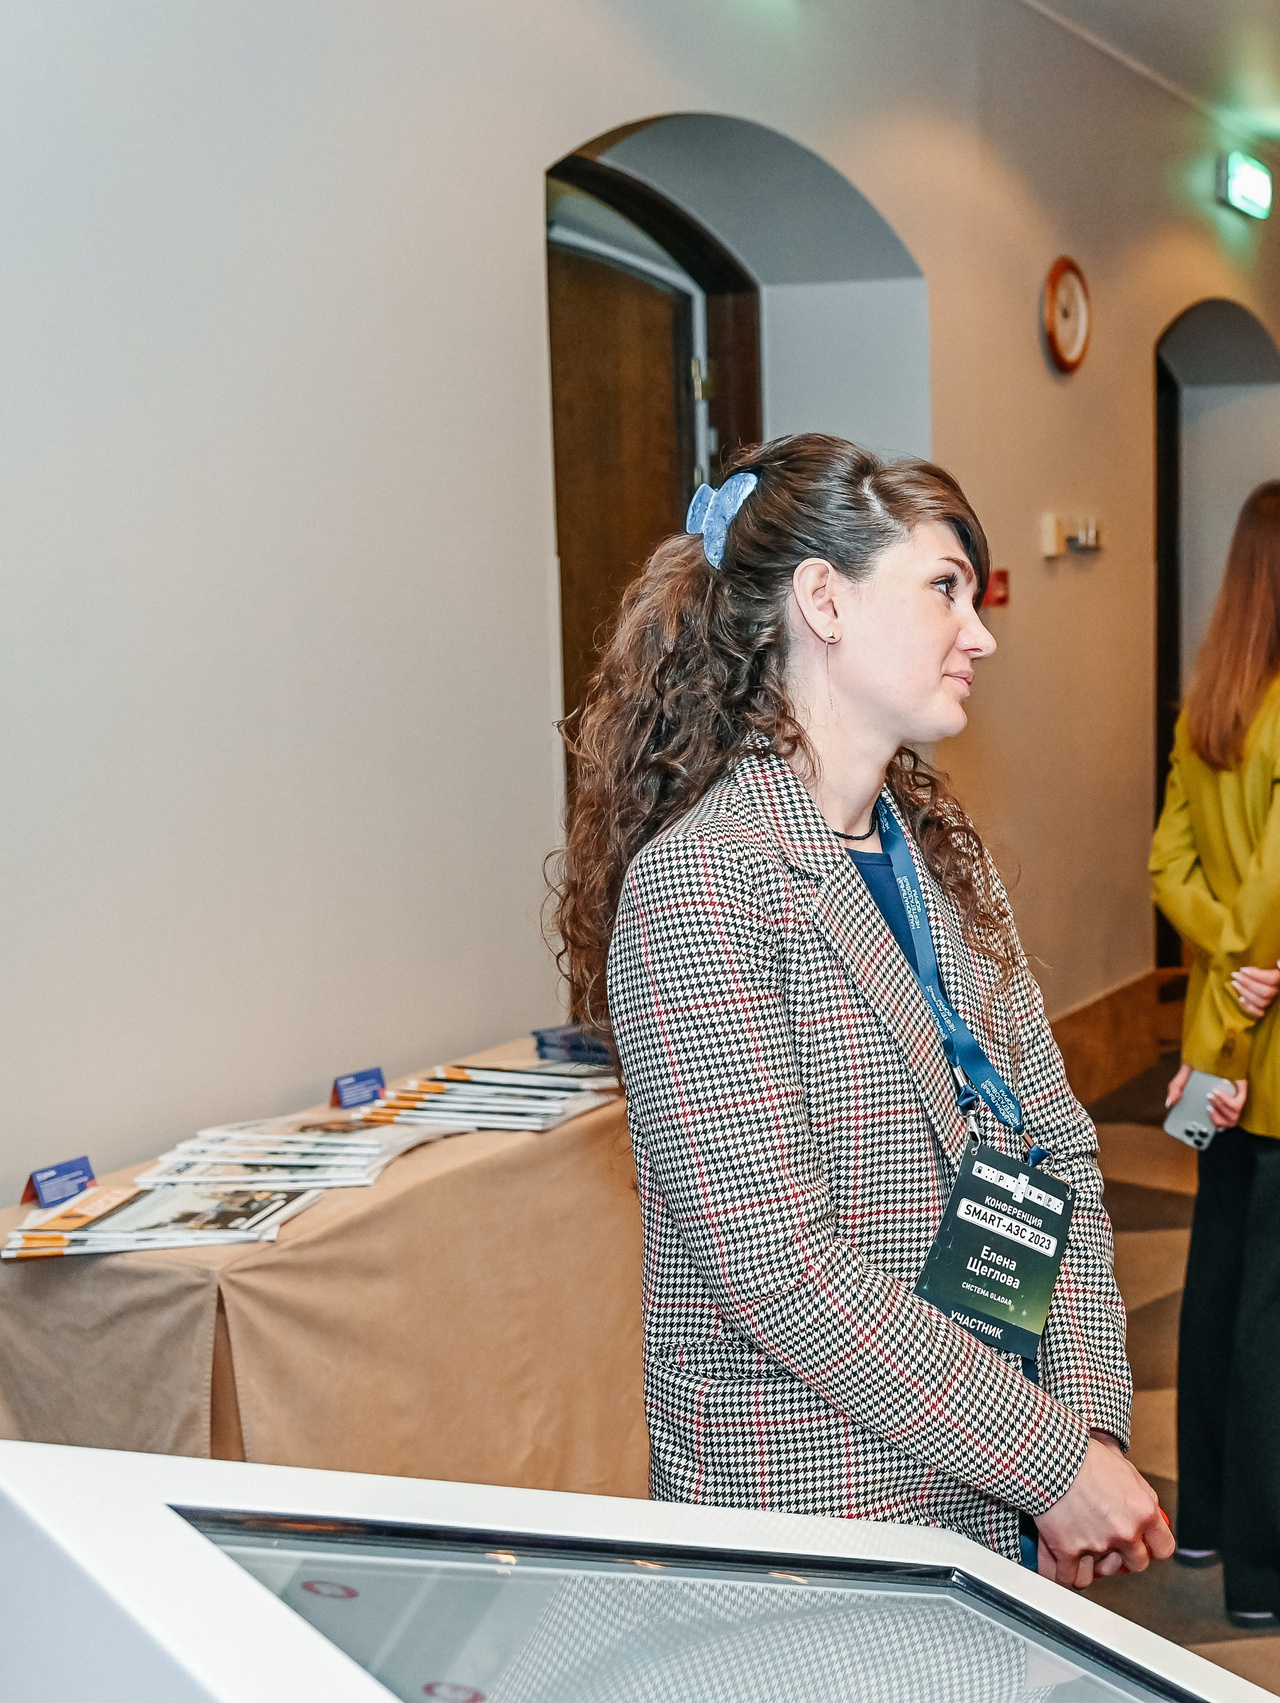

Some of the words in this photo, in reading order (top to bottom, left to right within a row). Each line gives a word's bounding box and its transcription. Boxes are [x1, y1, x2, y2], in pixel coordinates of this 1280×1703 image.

[896, 876, 916, 930] НАЦИОНАЛЬНЫЙ
[901, 875, 921, 929] НЕФТЕГАЗОВЫЙ
[911, 889, 922, 913] ФОРУМ
[985, 1079, 1021, 1127] НЕФТЕГАЗОВЫЙ
[999, 1089, 1016, 1110] ФОРУМ
[964, 1204, 1028, 1239] SMART-АЗС
[1028, 1231, 1052, 1250] 2023
[984, 1195, 1043, 1229] КОНФЕРЕНЦИЯ
[966, 1256, 1021, 1290] Щеглова
[980, 1245, 1017, 1272] Елена
[961, 1281, 990, 1298] СИСТЕМА
[950, 1310, 1004, 1340] УЧАСТНИК
